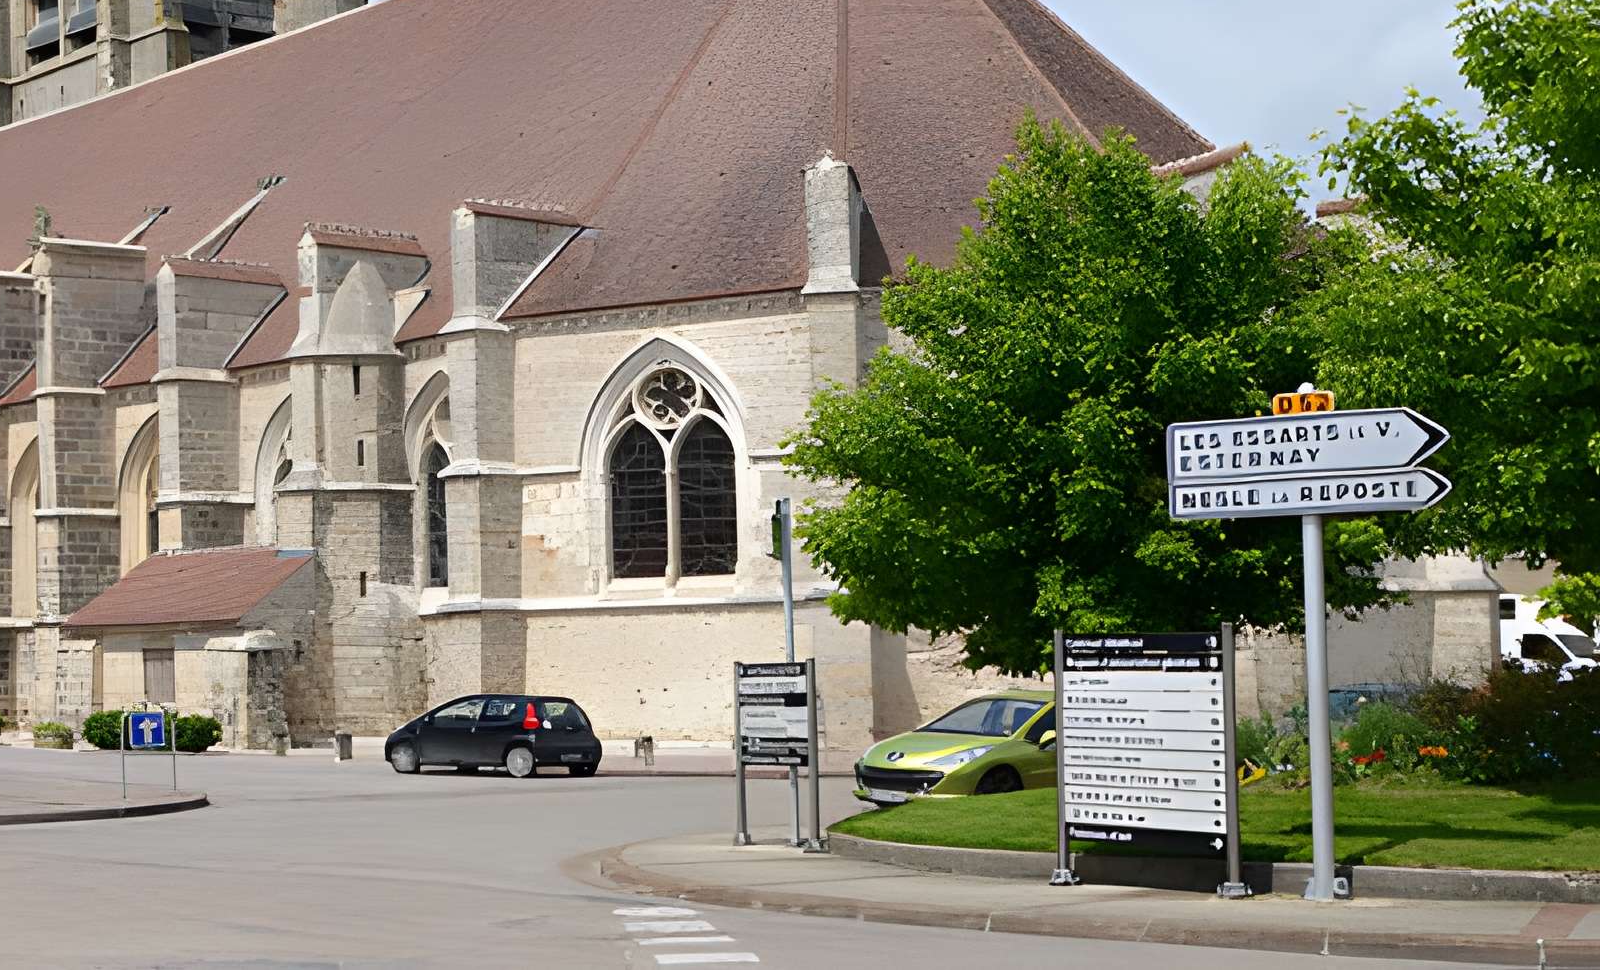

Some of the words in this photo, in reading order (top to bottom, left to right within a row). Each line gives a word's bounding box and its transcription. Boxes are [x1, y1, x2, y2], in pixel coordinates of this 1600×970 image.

[1180, 434, 1222, 451] LES
[1233, 424, 1339, 446] ESSARTS
[1180, 448, 1320, 471] ESTERNAY
[1181, 489, 1260, 508] NESLE
[1301, 480, 1417, 501] REPOSTE
